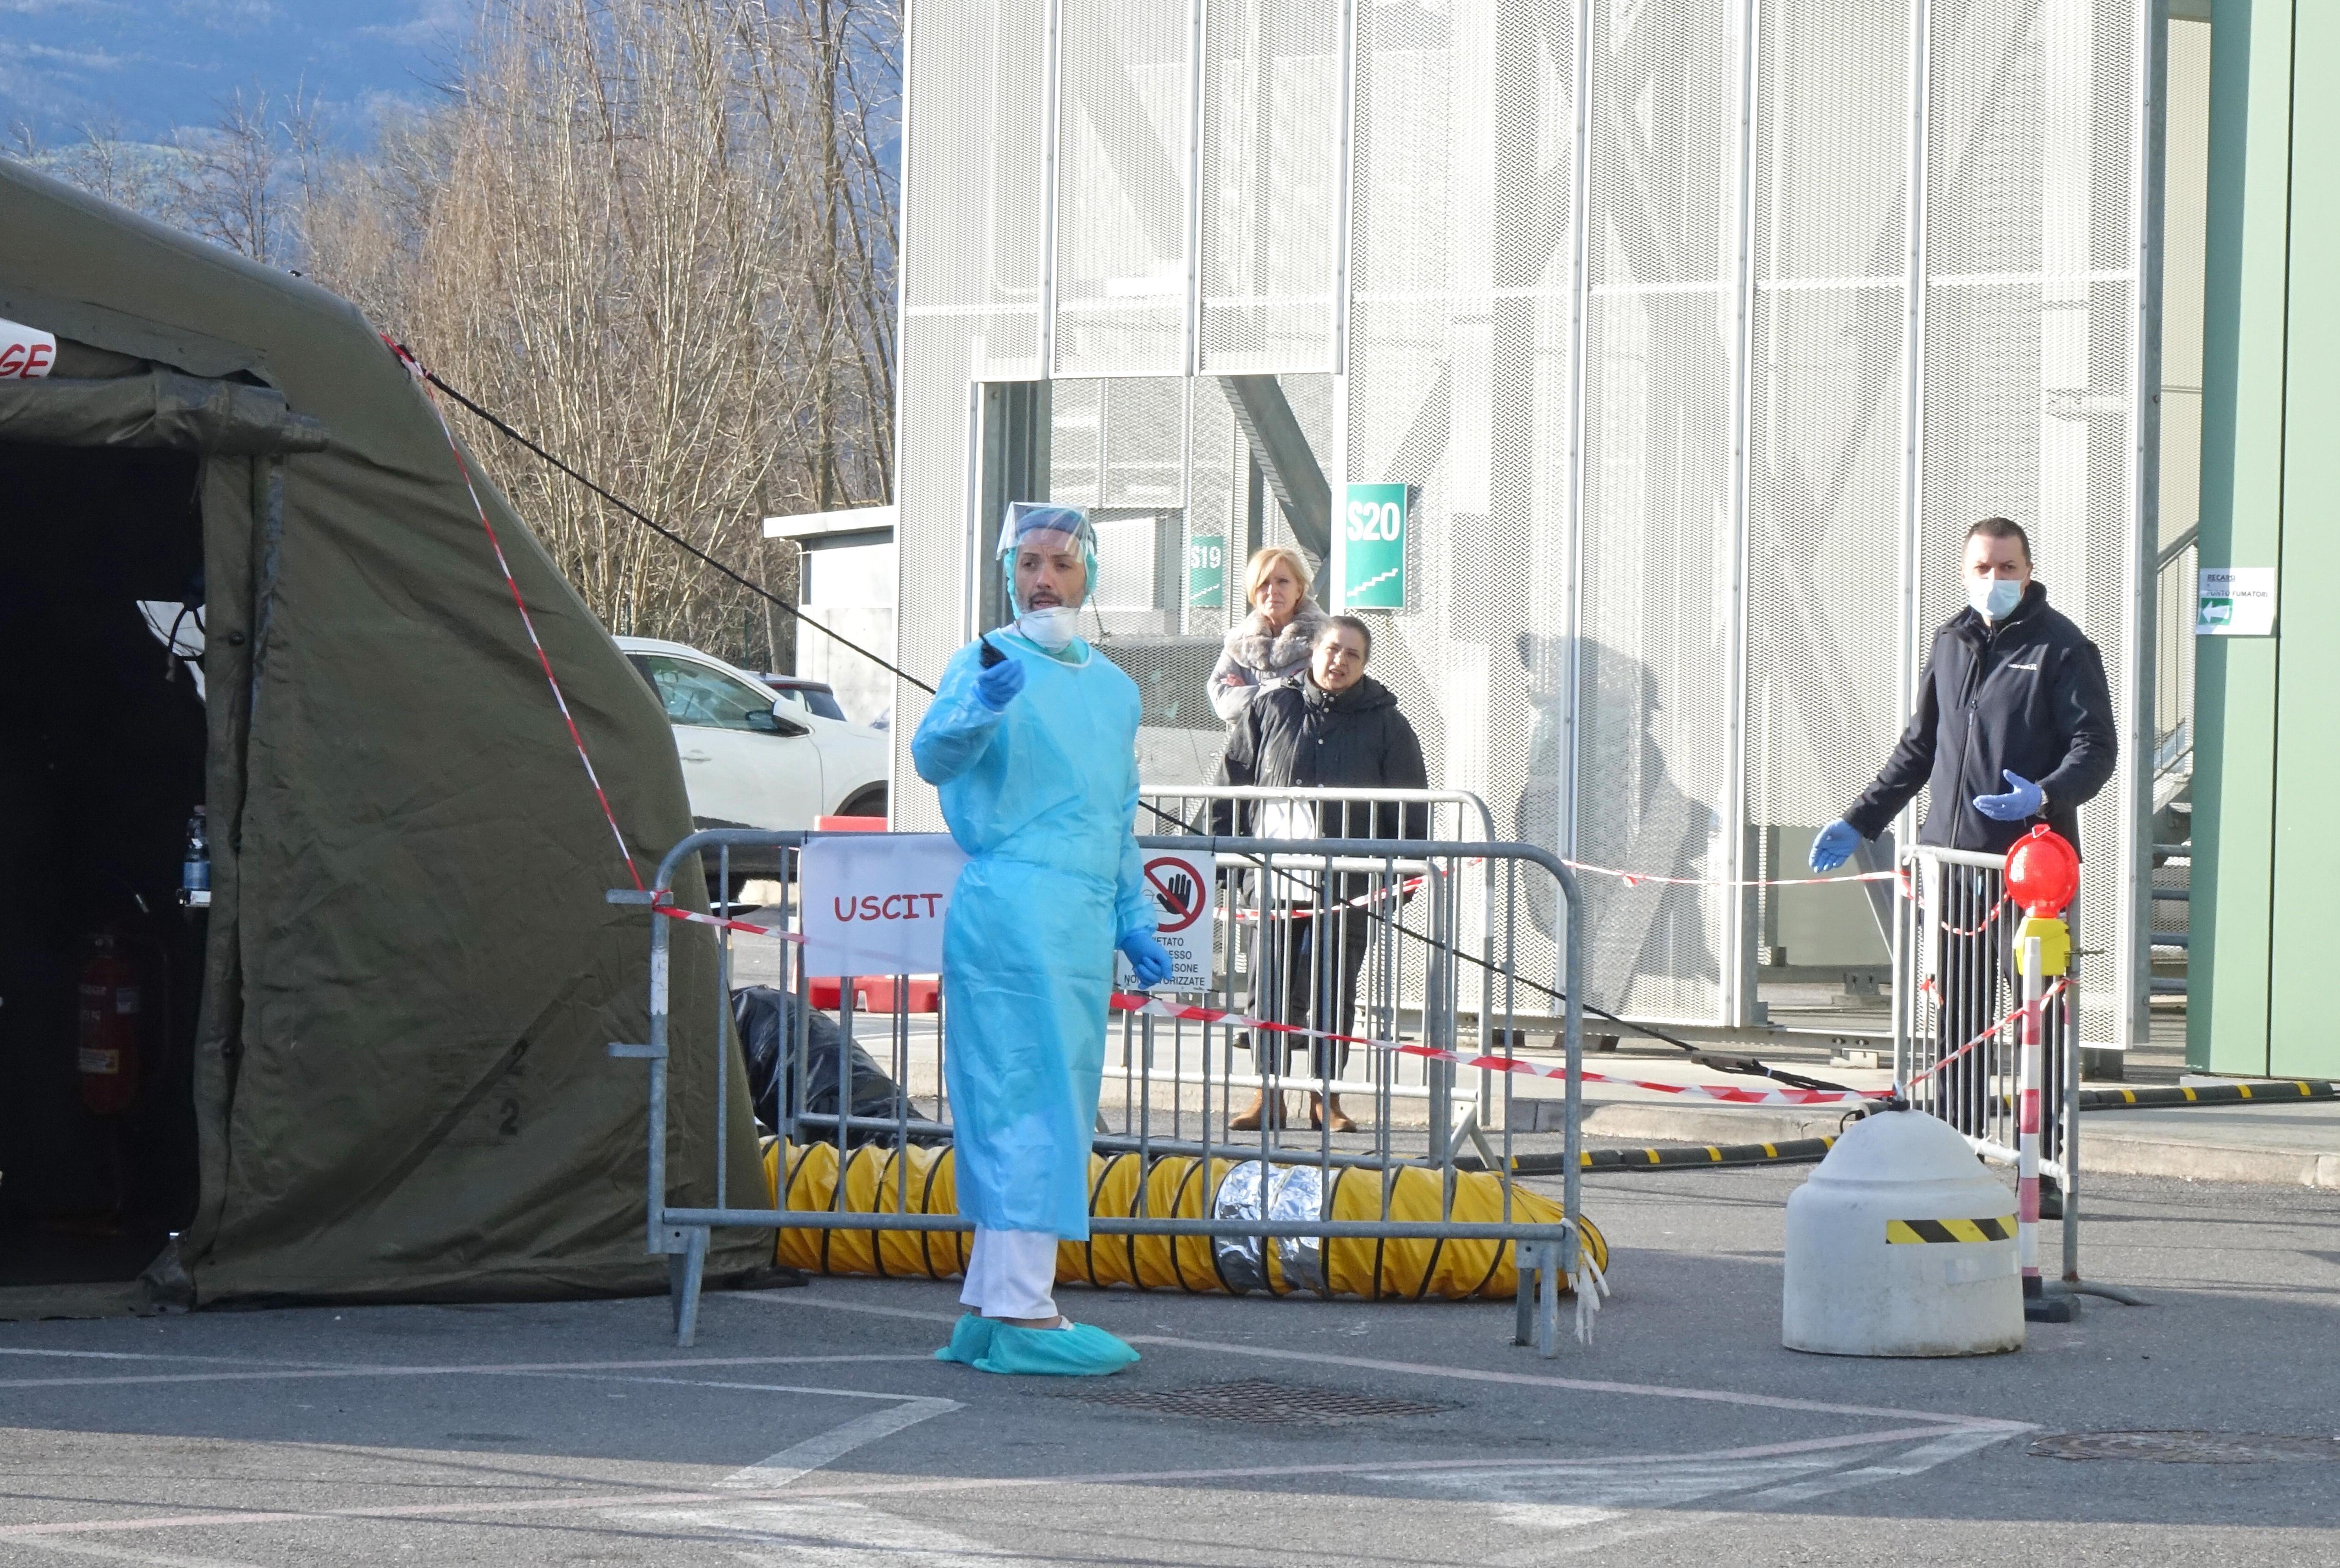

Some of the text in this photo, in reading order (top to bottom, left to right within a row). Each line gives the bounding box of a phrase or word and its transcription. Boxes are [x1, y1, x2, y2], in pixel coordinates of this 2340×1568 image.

[1347, 501, 1400, 541] S20
[1191, 546, 1221, 569] S19
[834, 893, 948, 922] USCIT
[1152, 937, 1184, 946] ETATO
[1169, 950, 1192, 960] ESSO
[1171, 963, 1198, 972] SONE
[500, 1098, 520, 1136] 2
